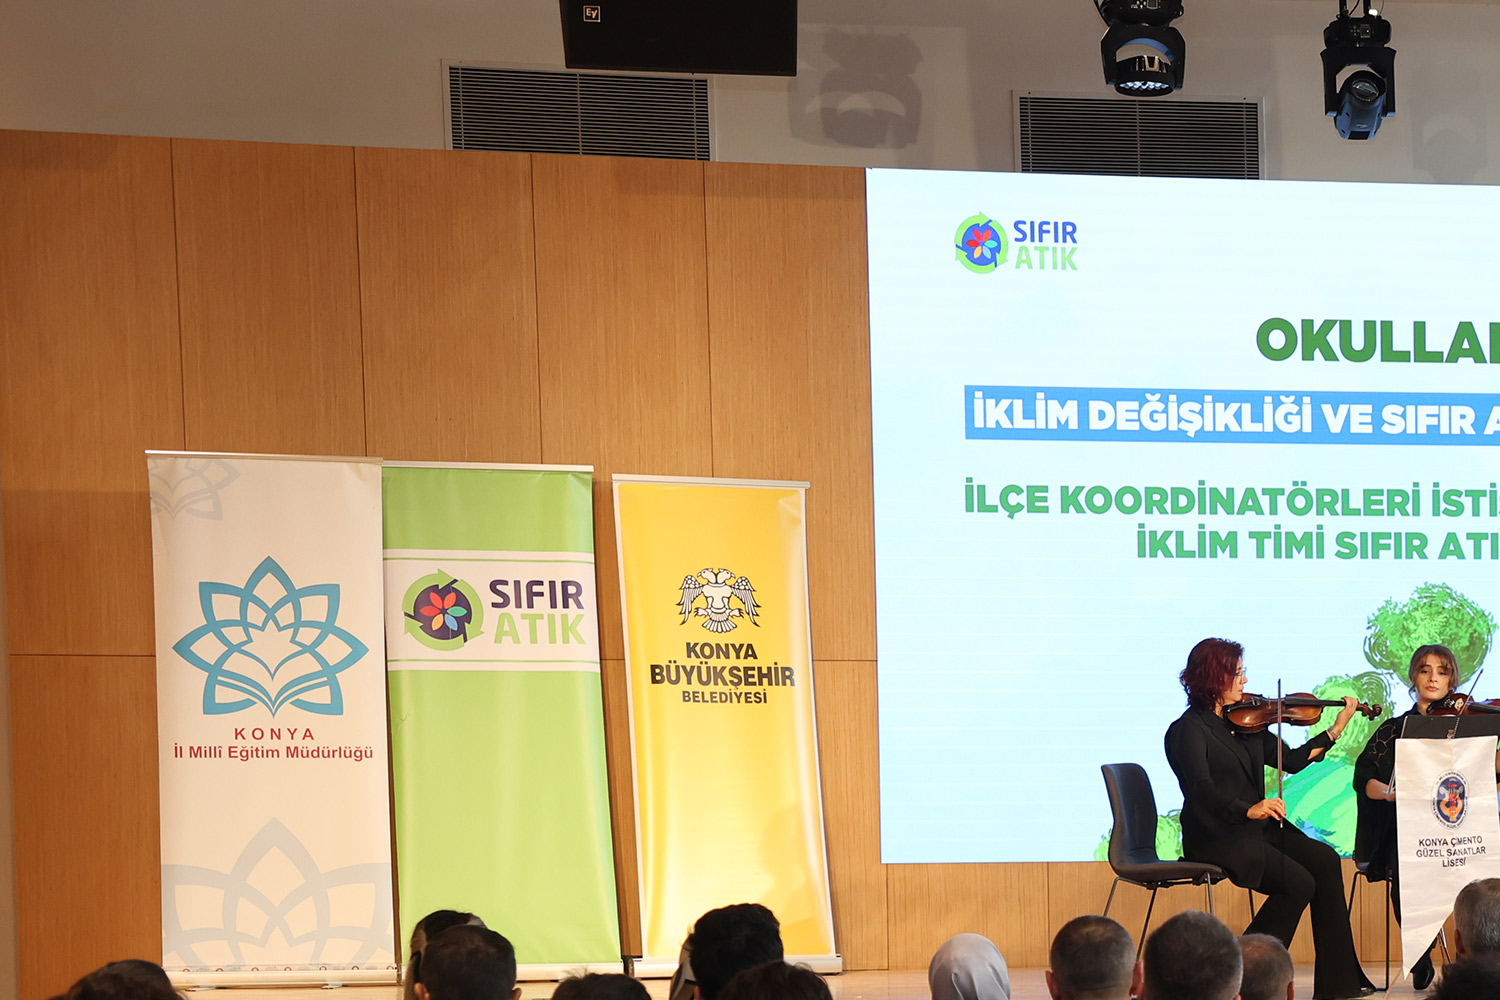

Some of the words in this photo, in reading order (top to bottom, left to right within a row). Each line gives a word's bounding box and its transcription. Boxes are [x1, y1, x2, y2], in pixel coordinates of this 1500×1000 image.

[1013, 220, 1078, 244] SIFIR
[1015, 245, 1078, 271] ATIK
[973, 391, 1079, 430] İKLİM
[1088, 393, 1312, 438] DEĞİŞİKLİĞİ
[1320, 403, 1373, 434] VE
[1380, 404, 1476, 435] SIFIR
[965, 477, 1049, 519] İLÇE
[1060, 479, 1420, 516] KOORDİNATÖRLERİ
[1137, 523, 1238, 559] İKLİM
[1249, 523, 1325, 559] TİMİ
[1334, 531, 1429, 560] SIFIR
[489, 579, 585, 609] SIFIR
[494, 612, 587, 645] ATIK
[685, 642, 758, 660] KONYA
[650, 660, 796, 690] BÜYÜKŞEHİR
[682, 689, 768, 704] BELEDİYESİ
[234, 727, 315, 740] KONYA
[174, 742, 183, 758] İl
[189, 745, 222, 758] Millî
[228, 745, 281, 762] Eğitim
[286, 745, 374, 762] Müdürlüğü
[1416, 848, 1444, 858] GÜZEL
[1446, 846, 1486, 857] SANATLAR
[1419, 838, 1449, 847] KONYA
[1442, 857, 1466, 867] LİSESİ
